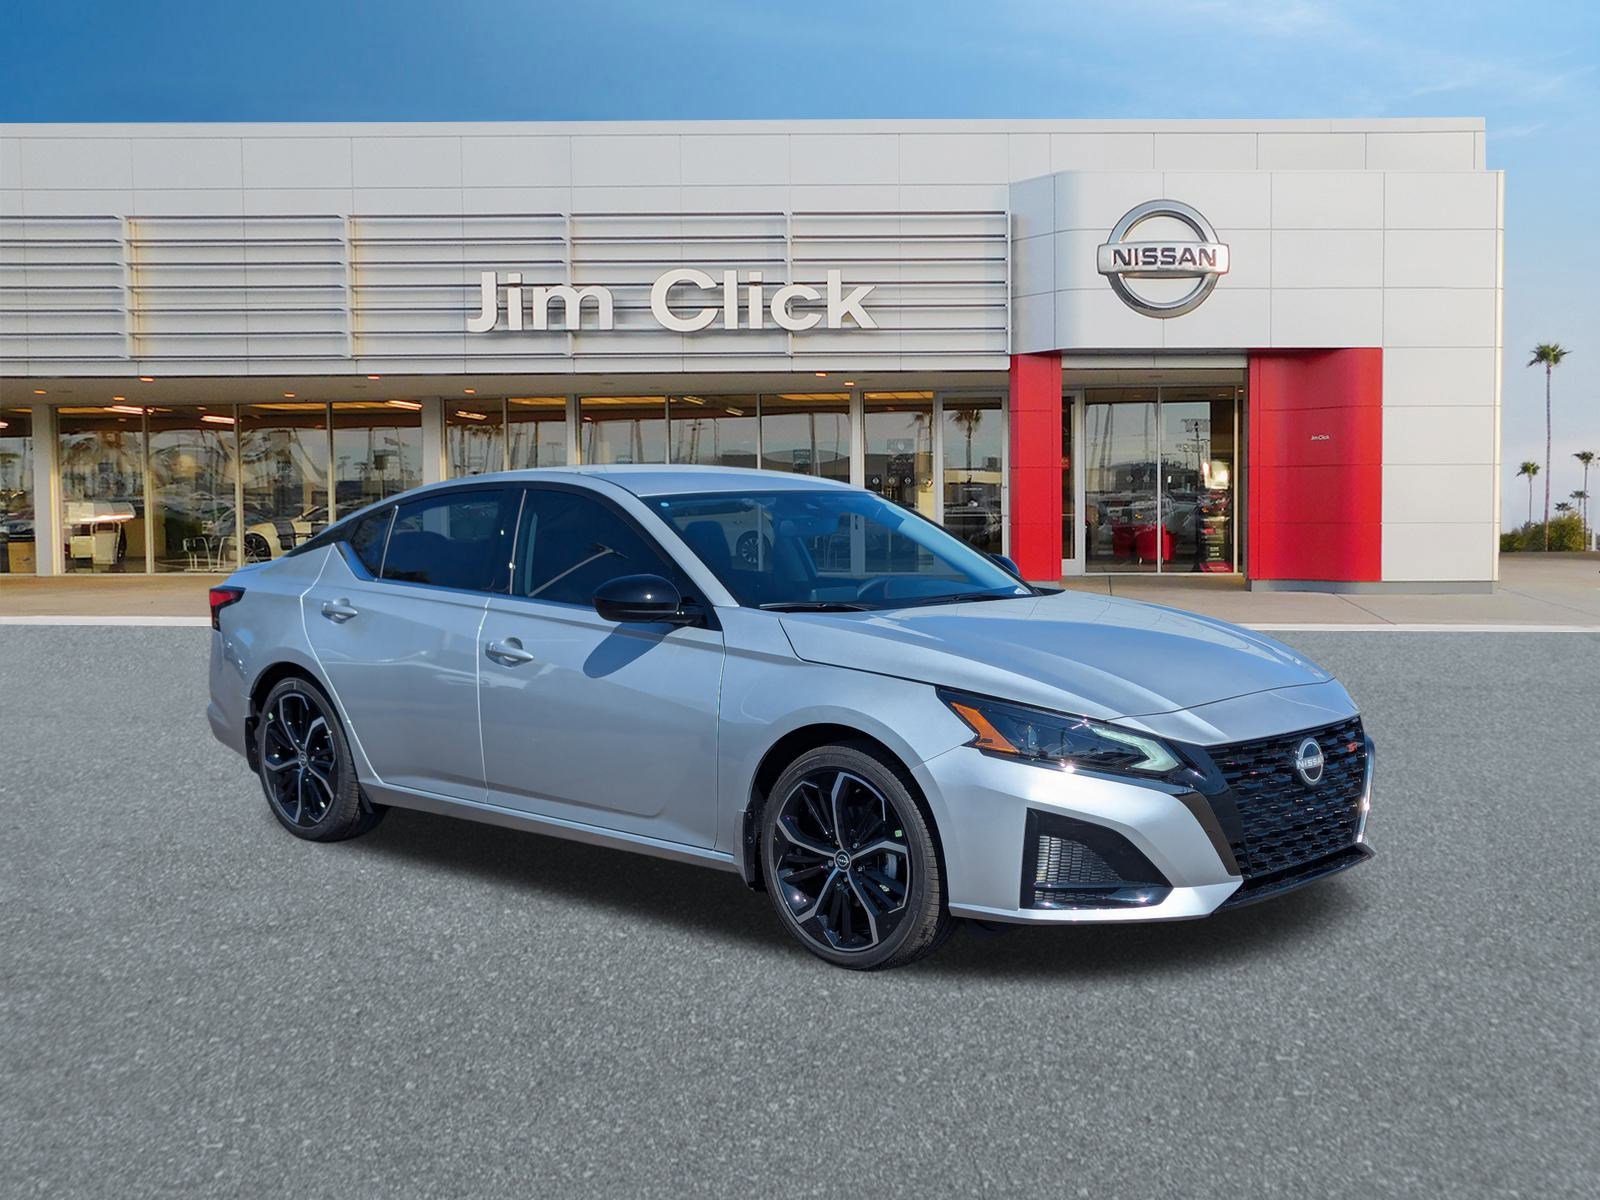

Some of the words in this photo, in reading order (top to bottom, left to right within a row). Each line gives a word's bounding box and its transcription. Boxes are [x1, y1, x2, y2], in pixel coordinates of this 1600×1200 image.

[1112, 247, 1217, 267] NISSAN
[466, 270, 614, 333] Jim
[650, 268, 880, 333] Click
